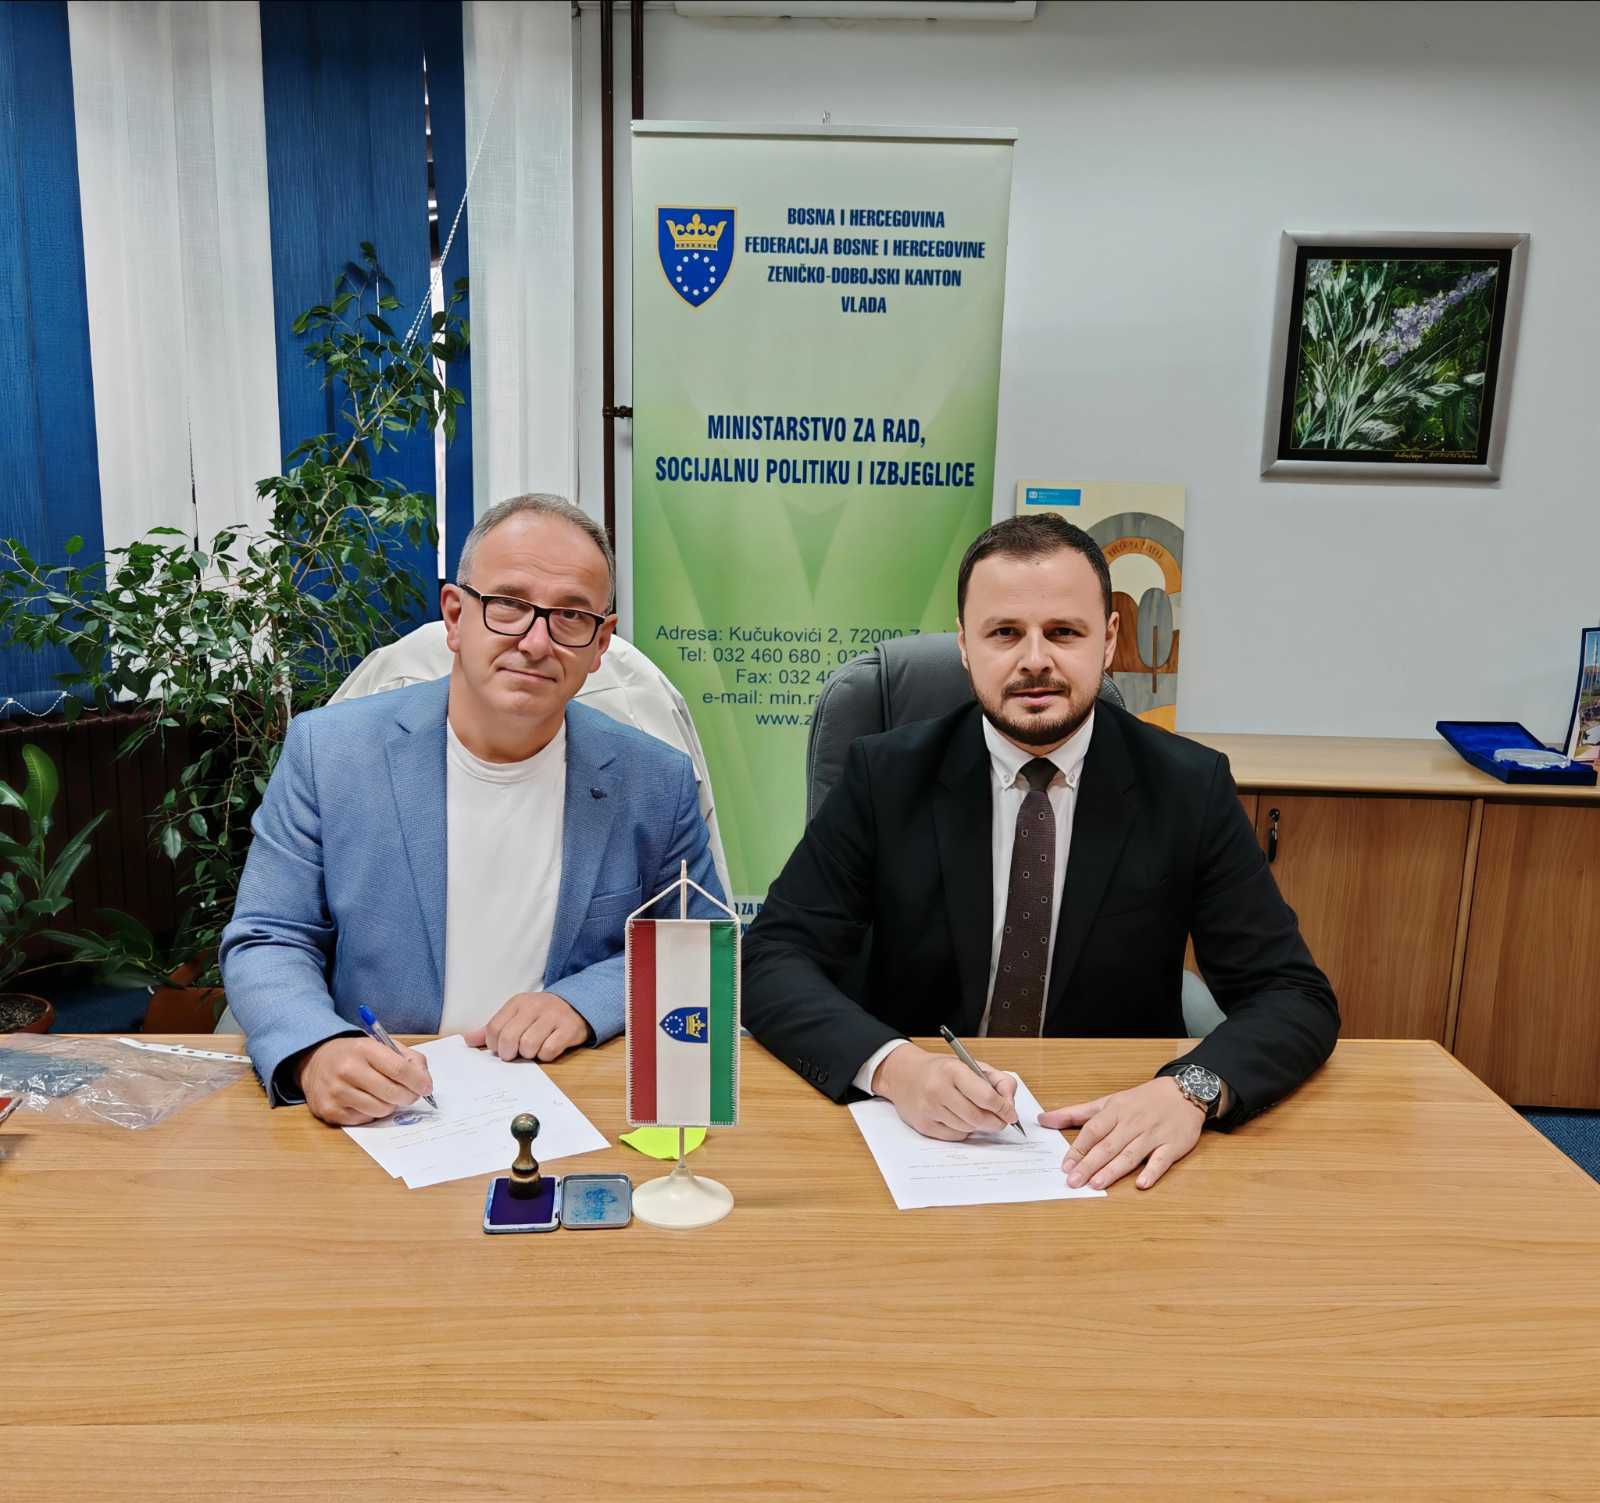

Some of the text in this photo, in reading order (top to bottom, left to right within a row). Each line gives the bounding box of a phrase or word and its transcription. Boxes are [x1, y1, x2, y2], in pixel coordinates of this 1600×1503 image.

[787, 207, 945, 229] BOSNA I HERCEGOVINA
[744, 236, 986, 259] FEDERACIJA BOSNE I HERCEGOVINE
[767, 263, 962, 287] ZENIČKO-DOBOJSKI KANTON
[841, 295, 887, 314] VLADA
[707, 414, 926, 448] MINISTARSTVO ZA RAD,
[655, 456, 976, 488] SOCIJALNU POLITIKU I IZBJEGLICE
[655, 624, 723, 642] Adresa:
[728, 624, 822, 643] Kučukovići
[827, 627, 843, 645] 2,
[678, 646, 706, 662] Tel:
[713, 647, 745, 663] 032
[750, 647, 783, 664] 460
[788, 648, 821, 664] 680
[736, 668, 772, 685] Fax:
[778, 669, 811, 685] 032
[702, 689, 763, 705] e-mail:
